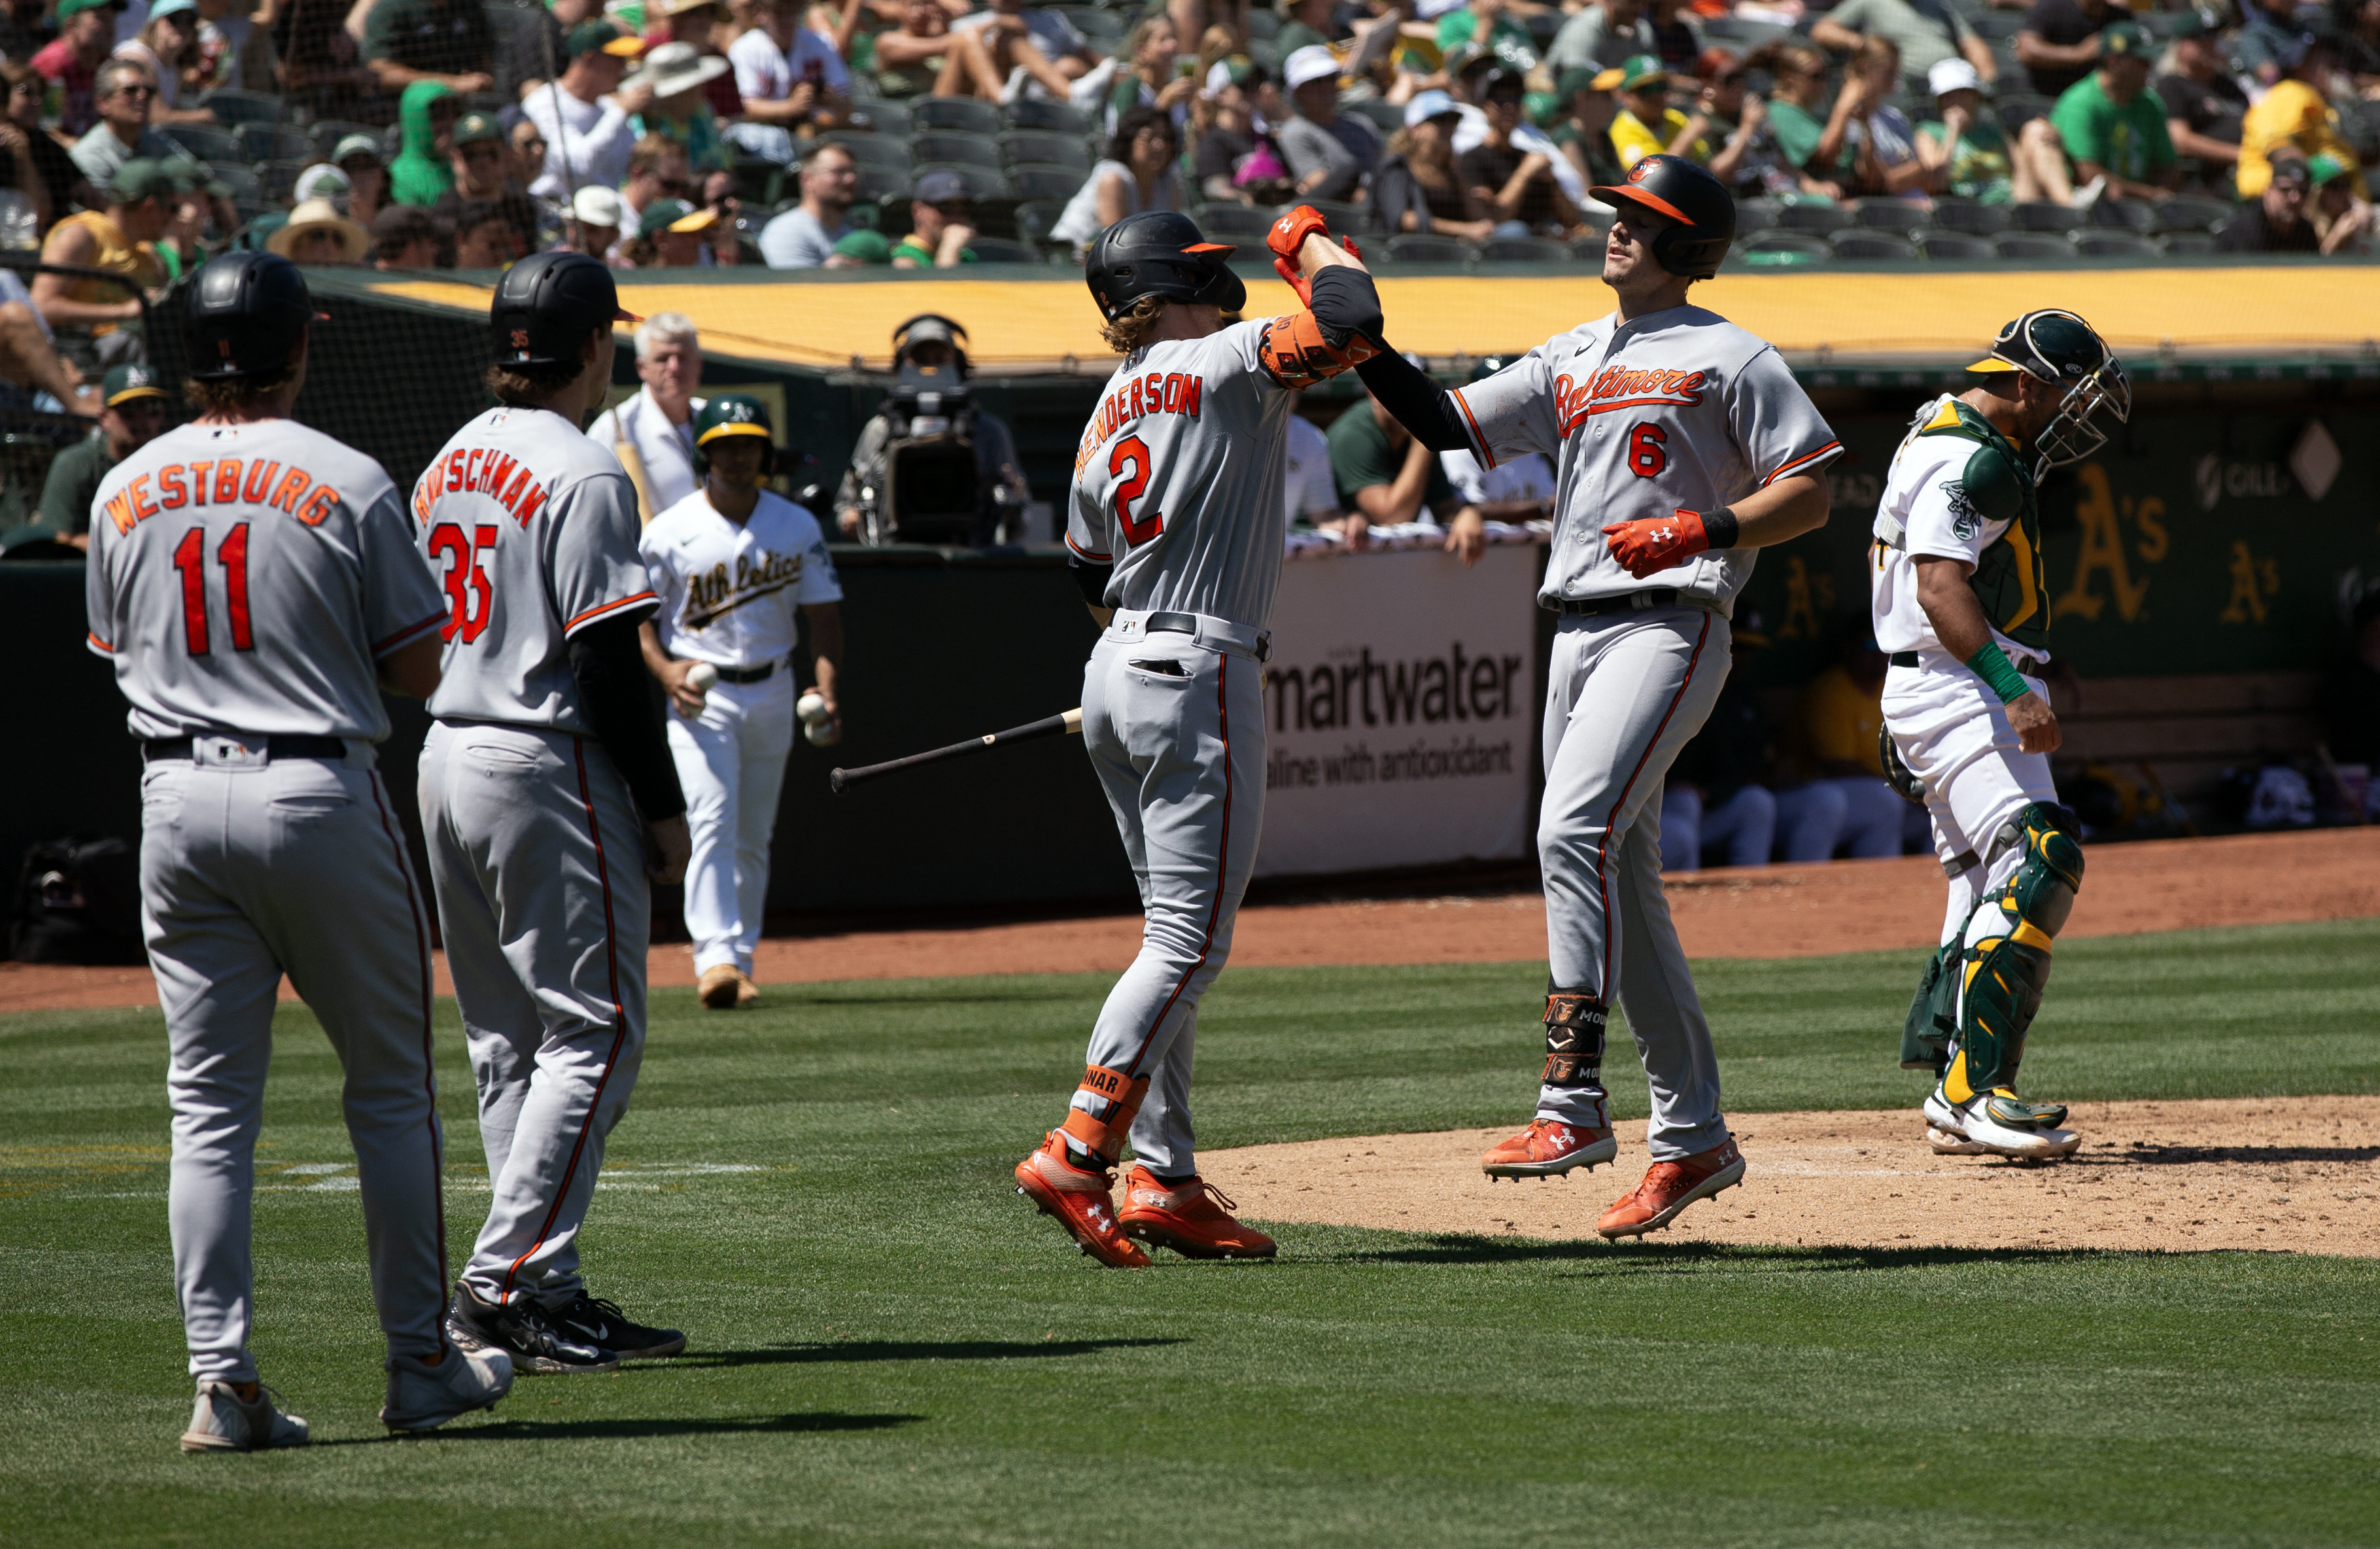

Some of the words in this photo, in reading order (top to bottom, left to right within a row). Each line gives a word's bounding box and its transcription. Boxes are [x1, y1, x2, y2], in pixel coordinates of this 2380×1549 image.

[511, 330, 528, 348] 35
[1100, 292, 1109, 306] 2
[1075, 372, 1203, 484] HENDERSON
[1555, 365, 1706, 439] Baltimore
[415, 448, 548, 531] RUTSCHMAN
[1628, 421, 1667, 478] 6
[105, 459, 340, 537] WESTBURG
[1108, 434, 1165, 549] 2
[2052, 463, 2169, 623] A's
[173, 522, 255, 656] 11
[428, 522, 498, 646] 35
[685, 553, 802, 632] Athletics
